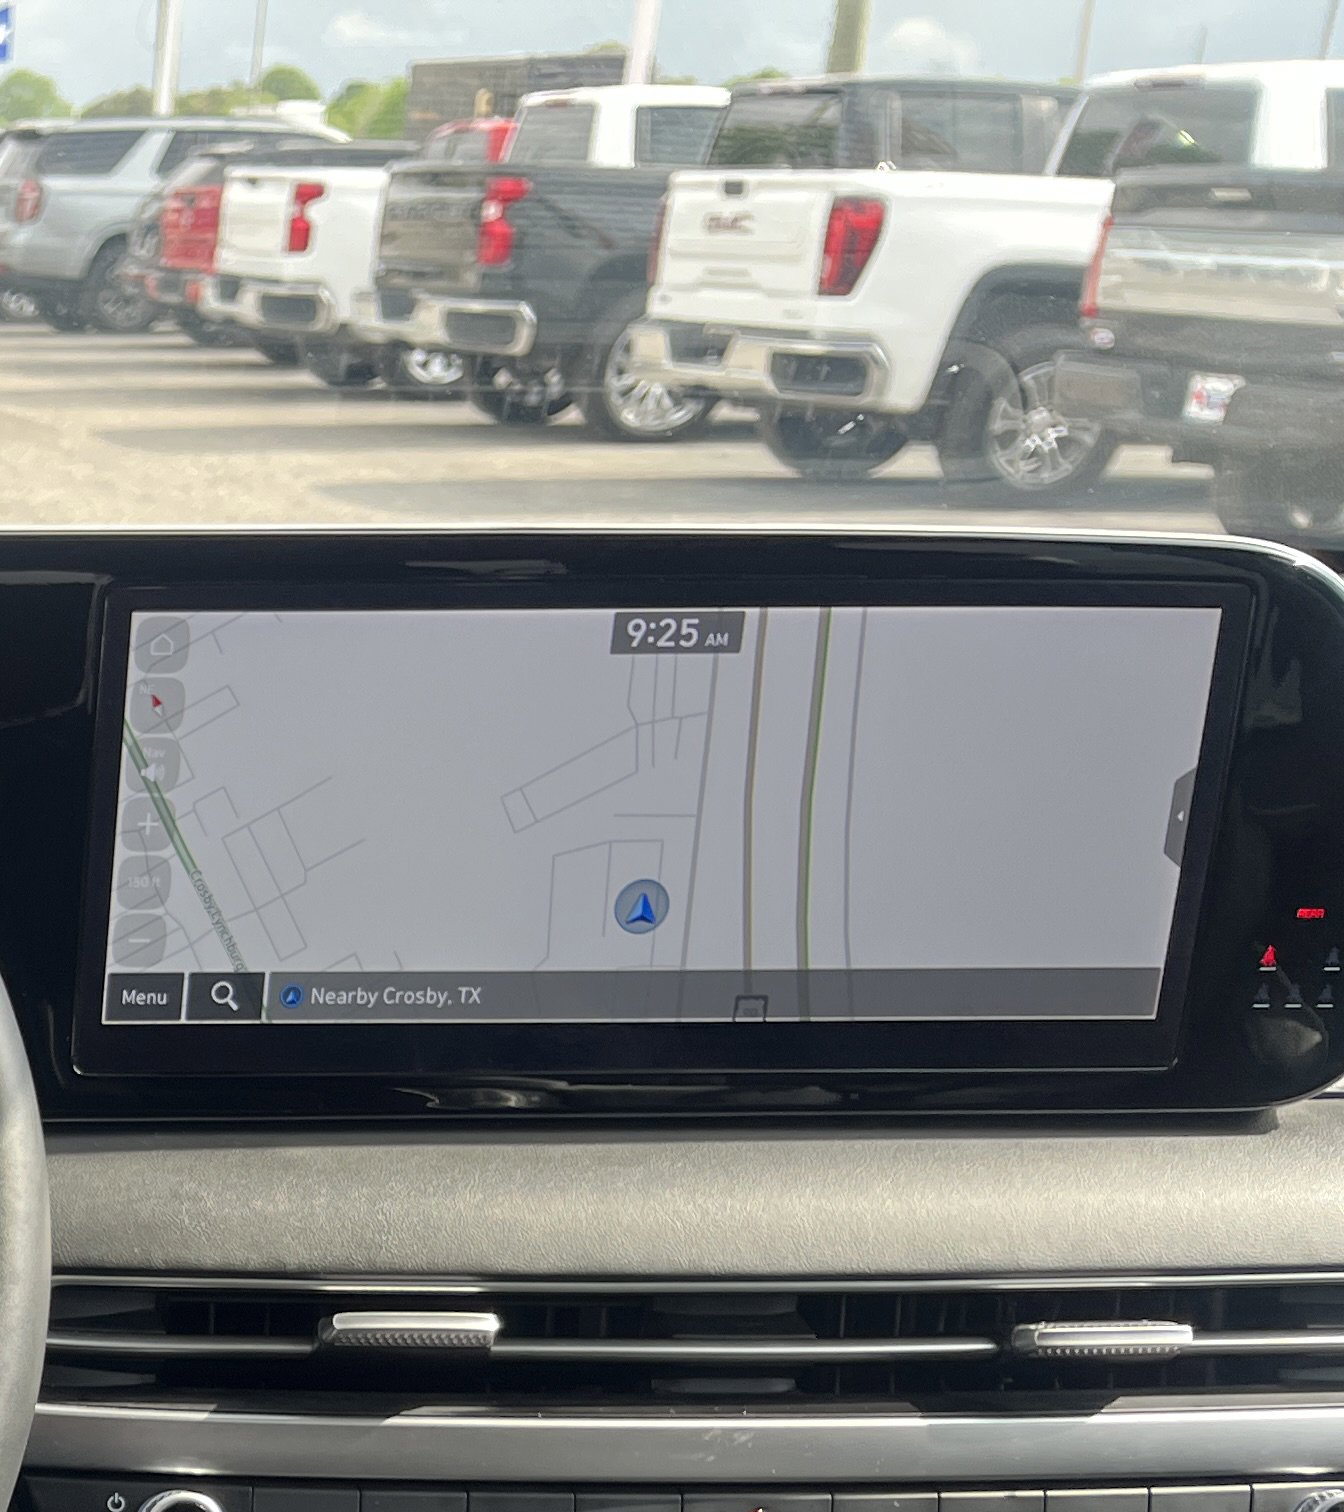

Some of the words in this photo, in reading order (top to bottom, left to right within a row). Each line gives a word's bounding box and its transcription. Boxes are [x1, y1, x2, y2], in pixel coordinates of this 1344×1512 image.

[626, 617, 700, 648] 9:25
[704, 632, 729, 647] AM
[121, 989, 167, 1005] Menu
[310, 986, 378, 1008] Nearby
[458, 986, 482, 1004] TX
